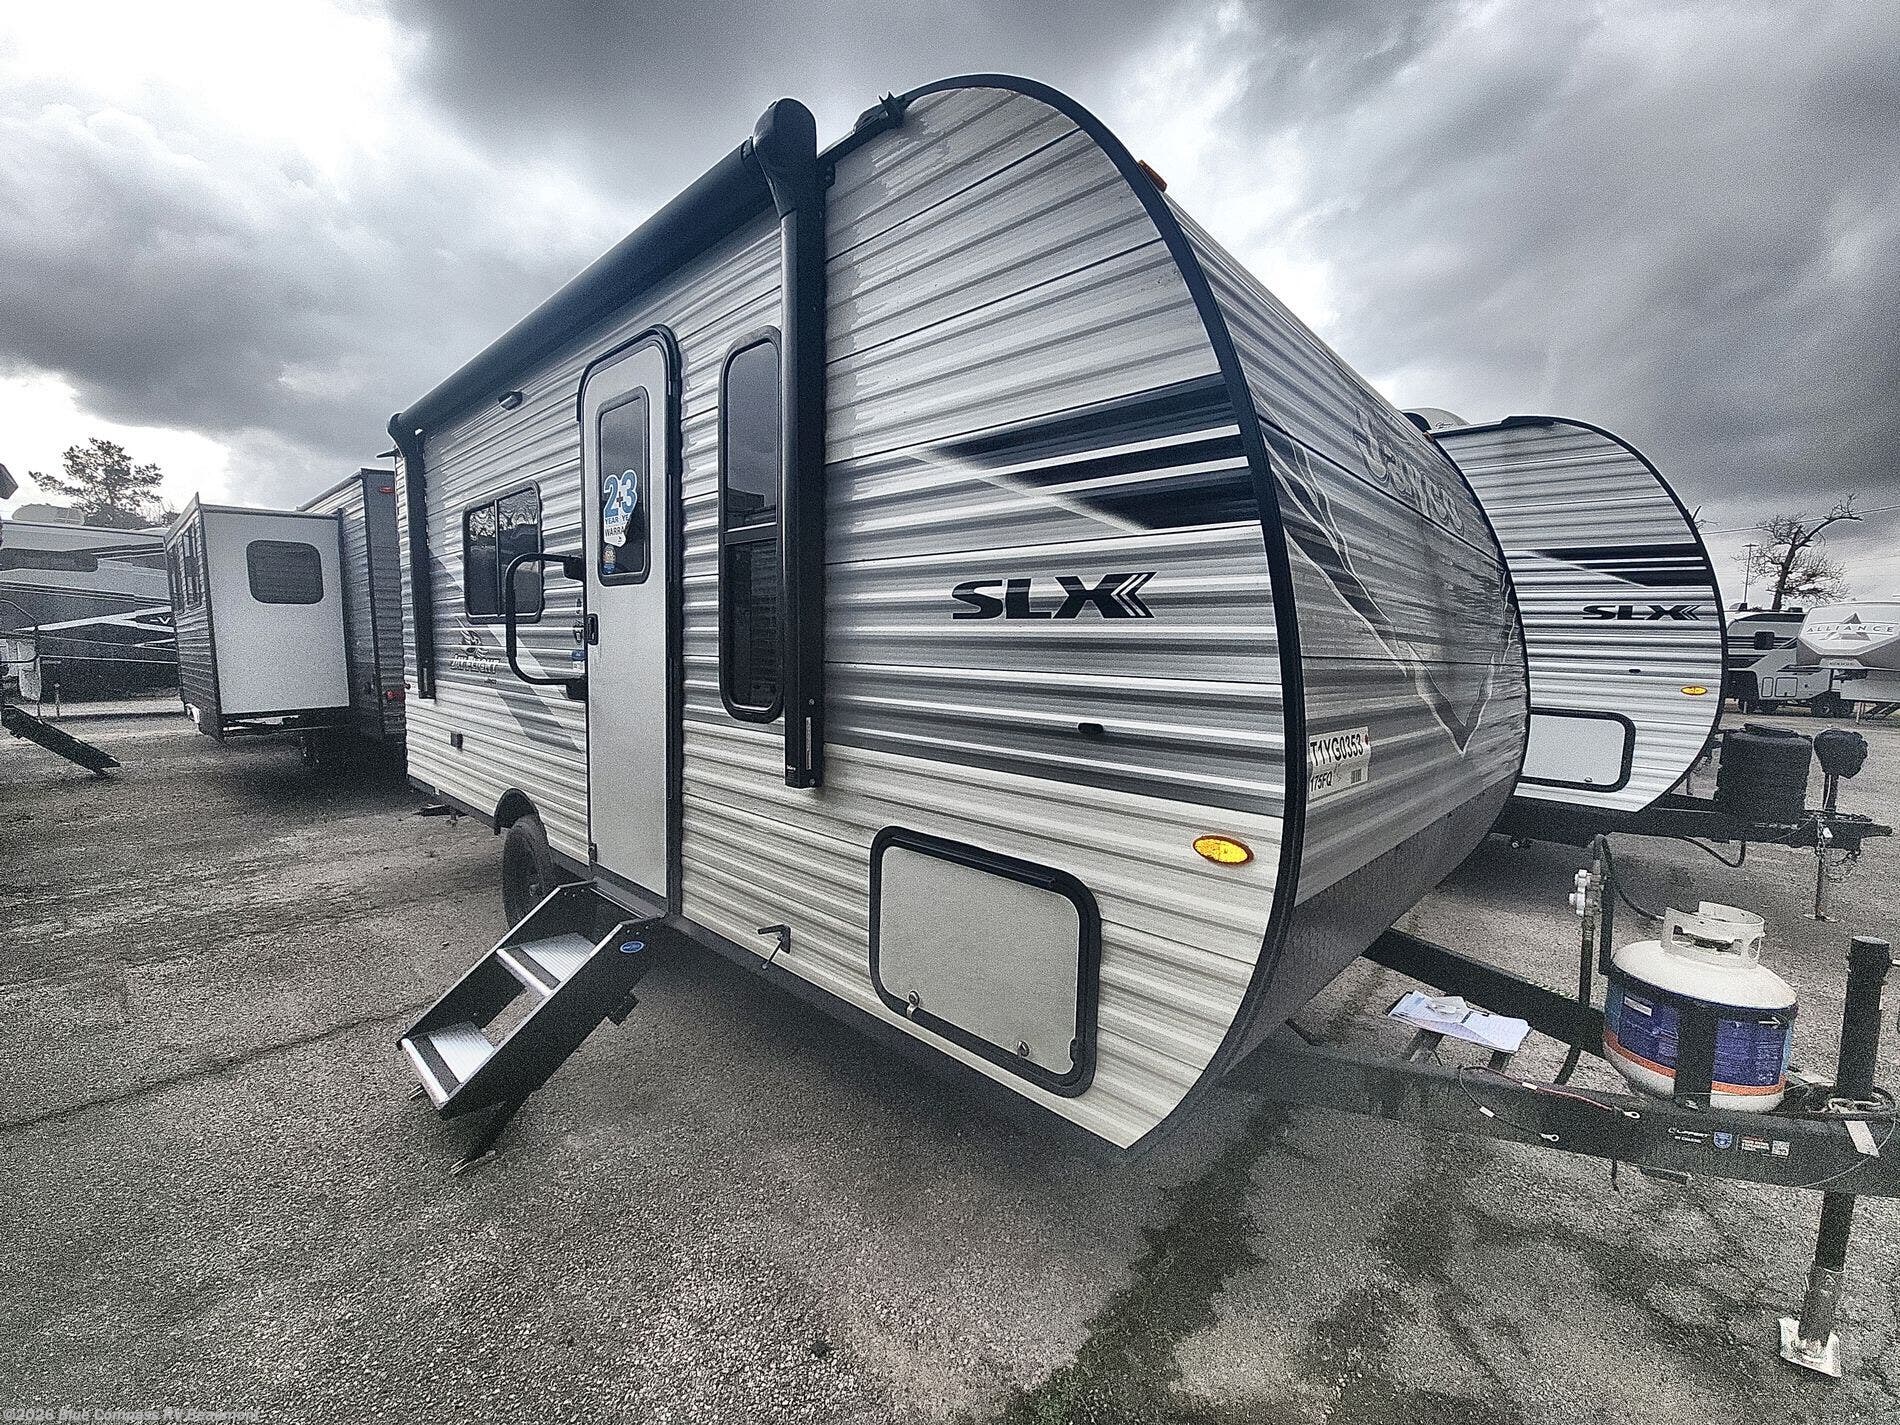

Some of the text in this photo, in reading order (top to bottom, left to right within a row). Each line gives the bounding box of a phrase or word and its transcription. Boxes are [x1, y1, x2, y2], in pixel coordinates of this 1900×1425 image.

[605, 526, 625, 537] WARRA
[952, 572, 1157, 619] SLX
[1583, 604, 1701, 620] SLX
[1806, 625, 1894, 633] ALLIANCE
[1310, 733, 1364, 767] T1YG0353
